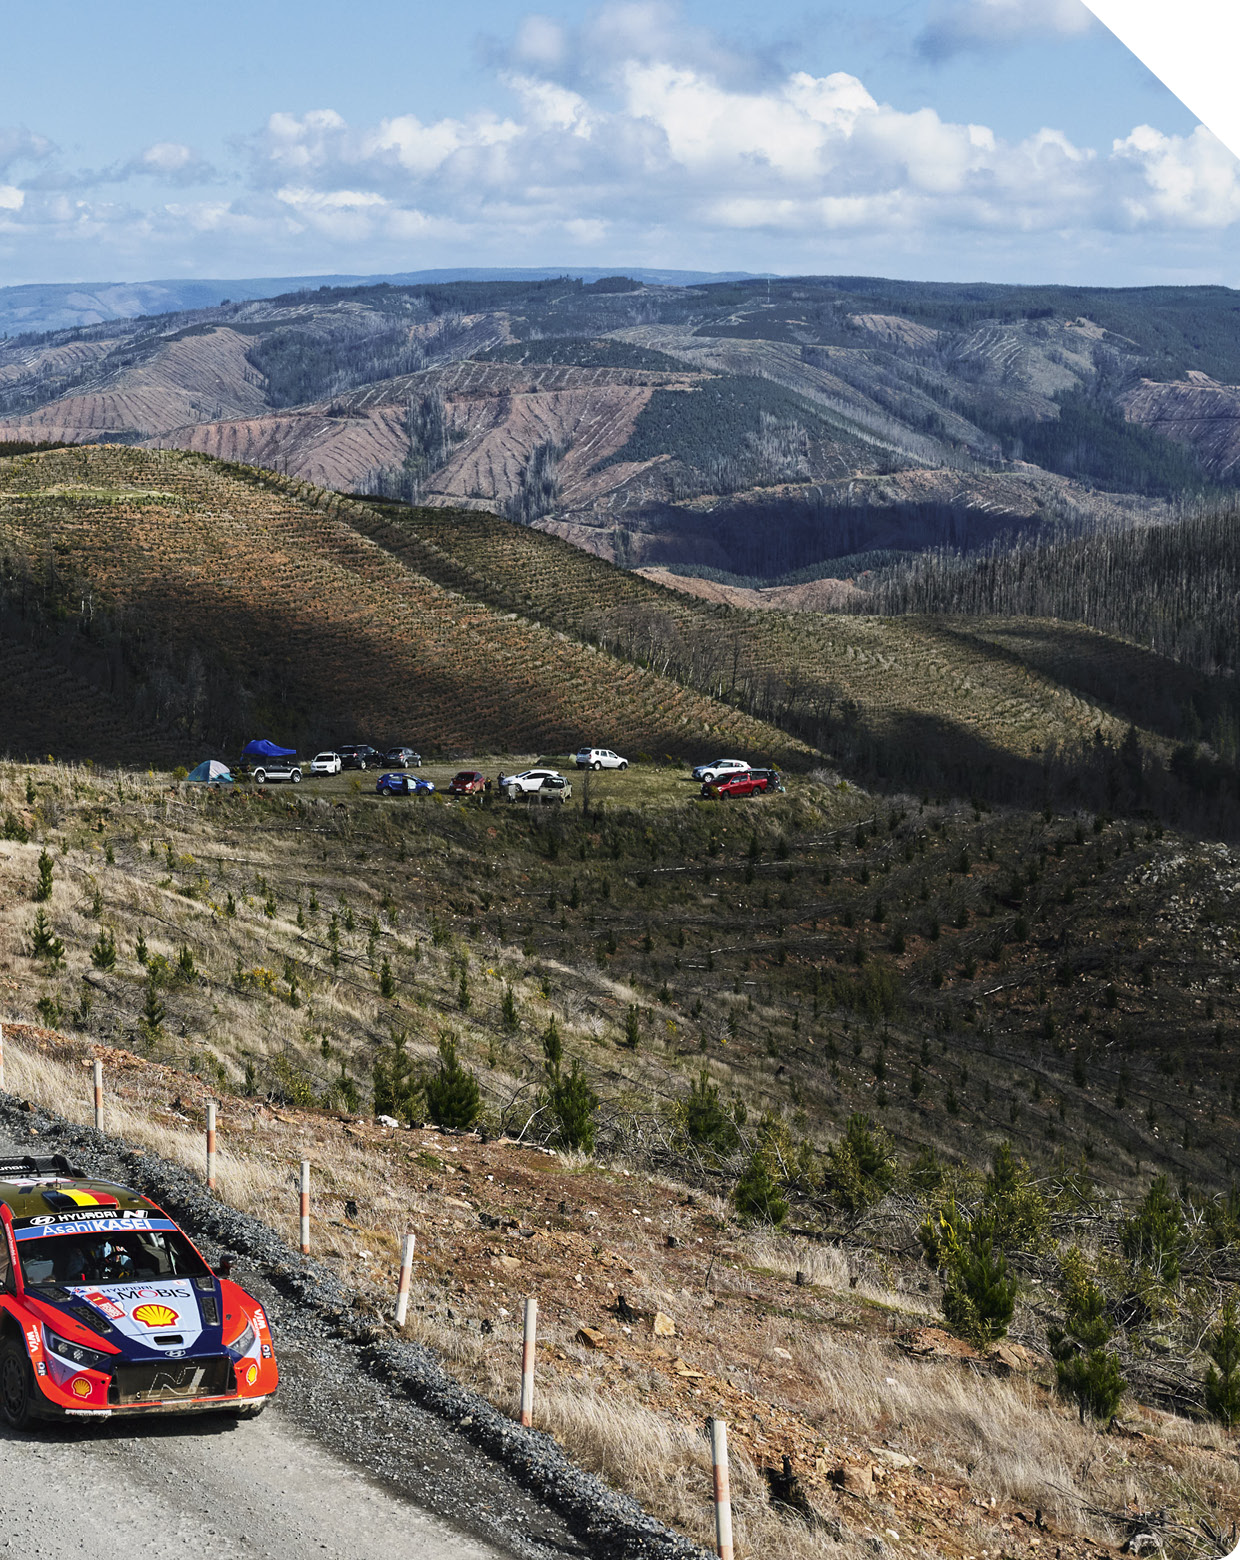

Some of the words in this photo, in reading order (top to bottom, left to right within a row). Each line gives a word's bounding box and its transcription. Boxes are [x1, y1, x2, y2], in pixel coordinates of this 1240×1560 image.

[57, 1211, 118, 1222] HYUNDAI
[42, 1218, 153, 1236] AsahiKASEI
[101, 1285, 153, 1293] HYUNDAI
[117, 1289, 190, 1300] MOBIS
